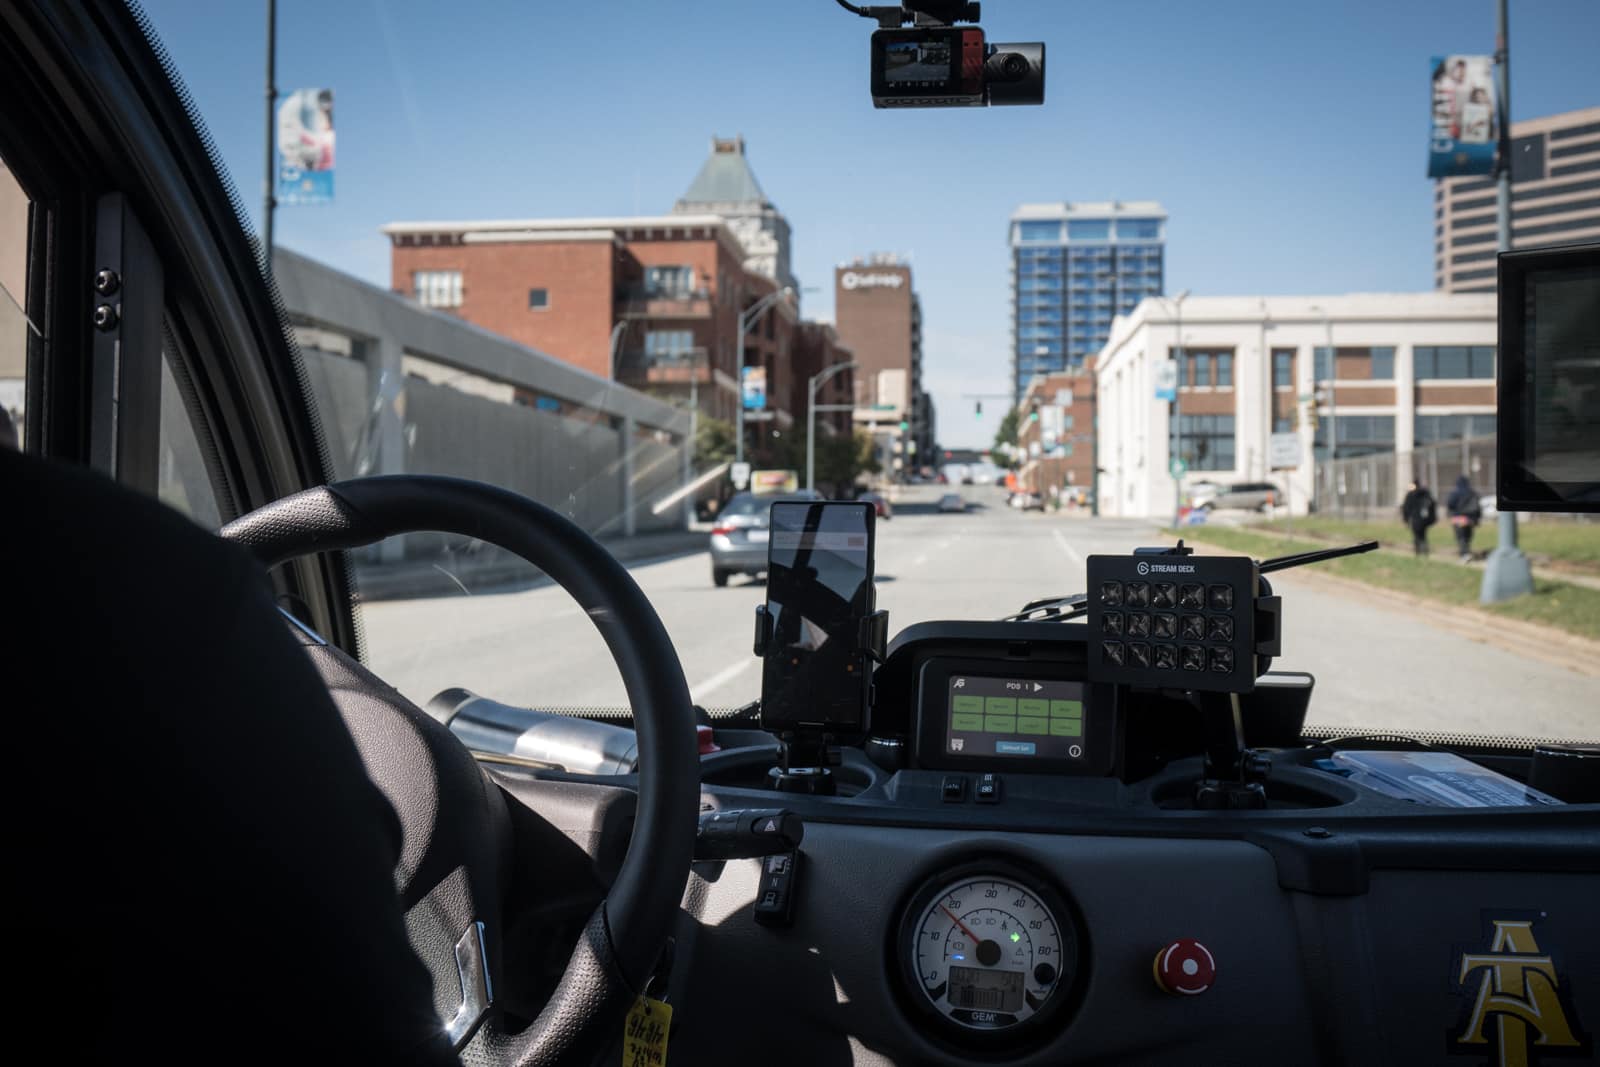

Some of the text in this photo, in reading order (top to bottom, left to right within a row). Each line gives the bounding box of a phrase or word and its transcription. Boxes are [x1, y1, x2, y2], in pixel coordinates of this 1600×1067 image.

[1150, 564, 1195, 573] STREAM DECK
[771, 877, 778, 887] N
[985, 889, 998, 898] 30
[949, 900, 961, 909] 20
[1013, 899, 1025, 908] 40
[1029, 920, 1042, 930] 50
[930, 931, 939, 941] 10
[1038, 946, 1051, 955] 60
[930, 971, 937, 980] 0
